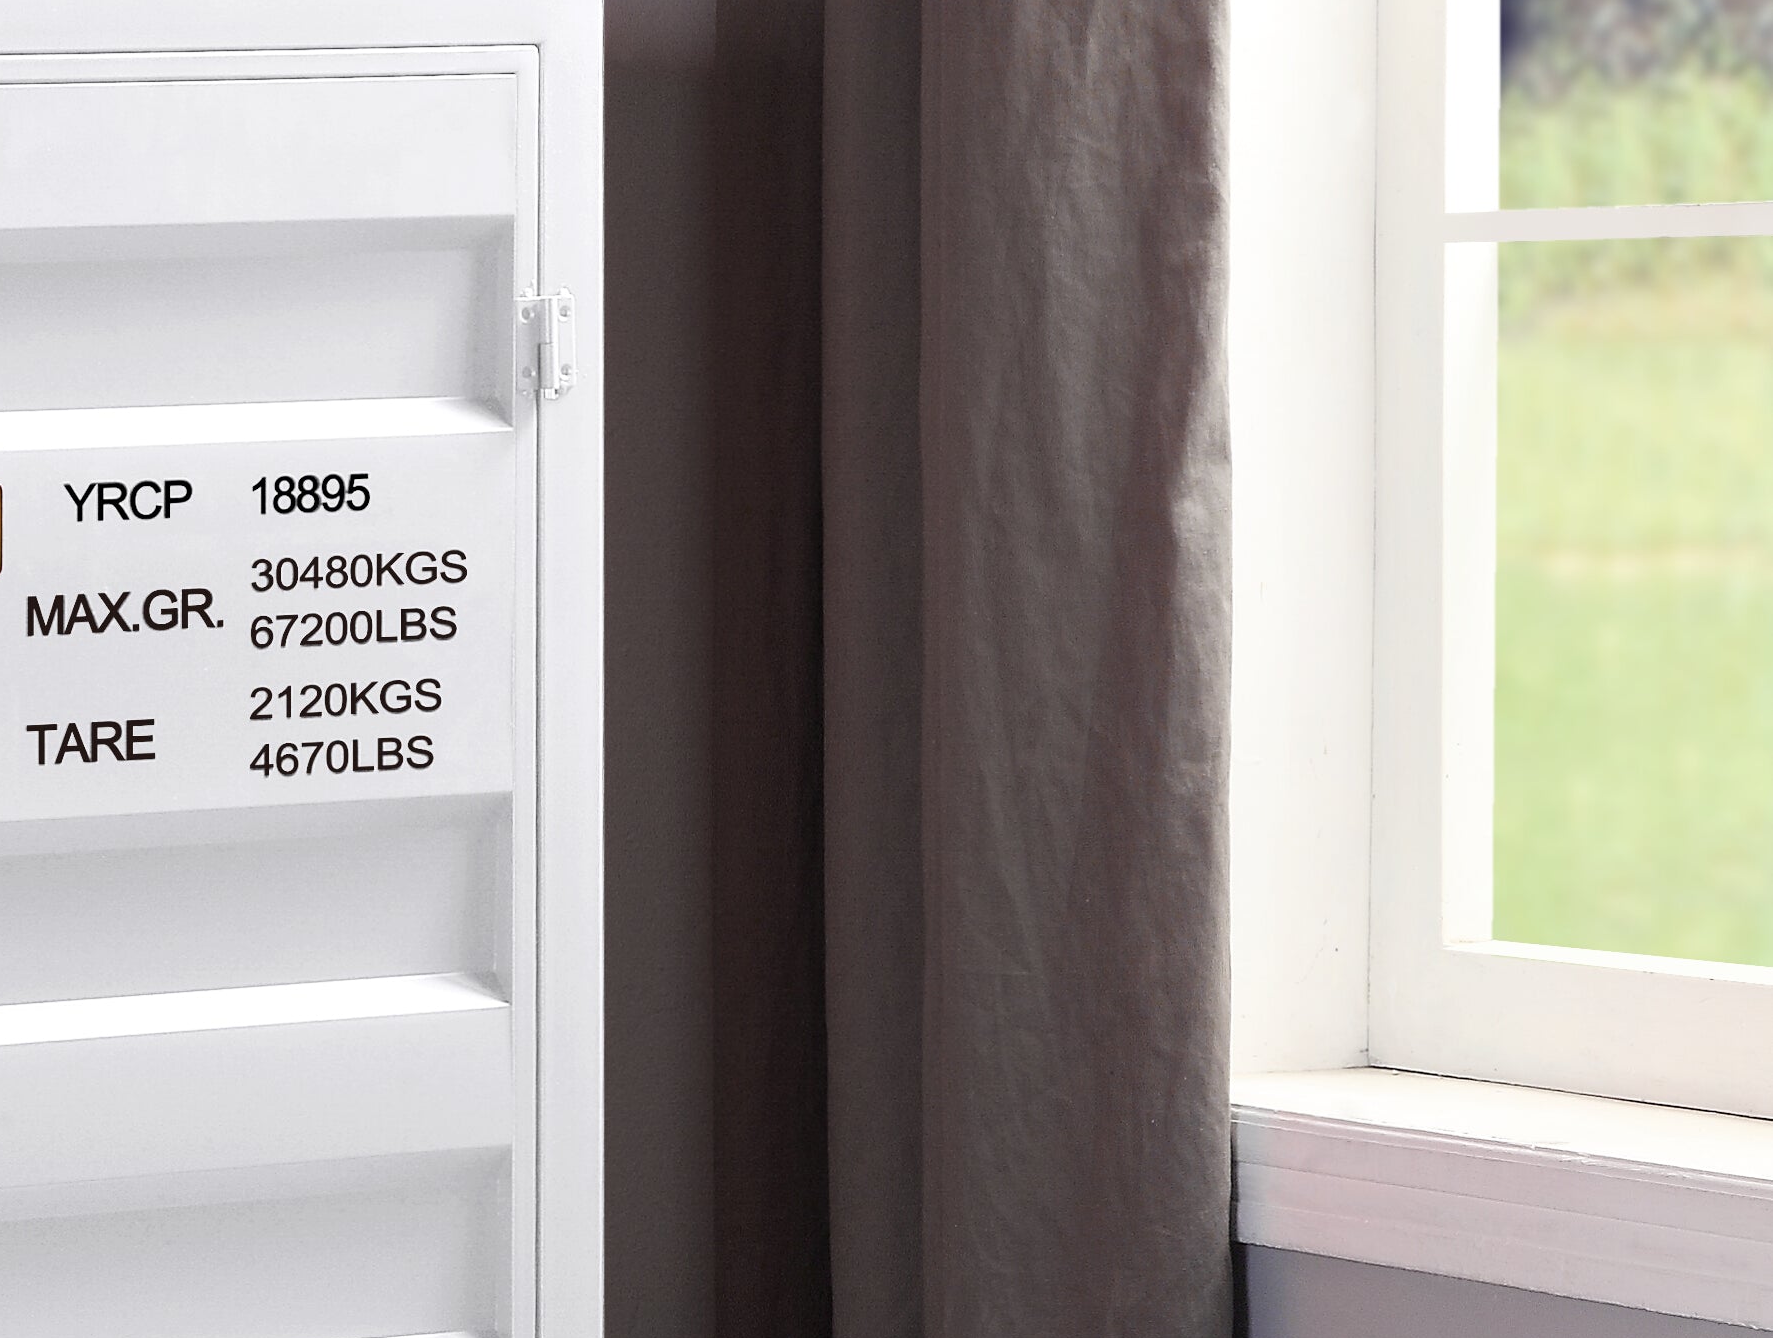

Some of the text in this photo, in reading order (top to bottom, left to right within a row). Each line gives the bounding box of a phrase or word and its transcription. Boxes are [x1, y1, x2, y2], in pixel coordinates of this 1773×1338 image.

[63, 473, 371, 522] YRCP 18895
[251, 549, 468, 593] 30480KGS
[27, 588, 224, 637] MAX.GR.
[250, 605, 458, 650] 67200LBS
[249, 678, 442, 721] 2120KGS
[26, 718, 156, 765] TARE
[249, 735, 434, 777] 4670LBS
